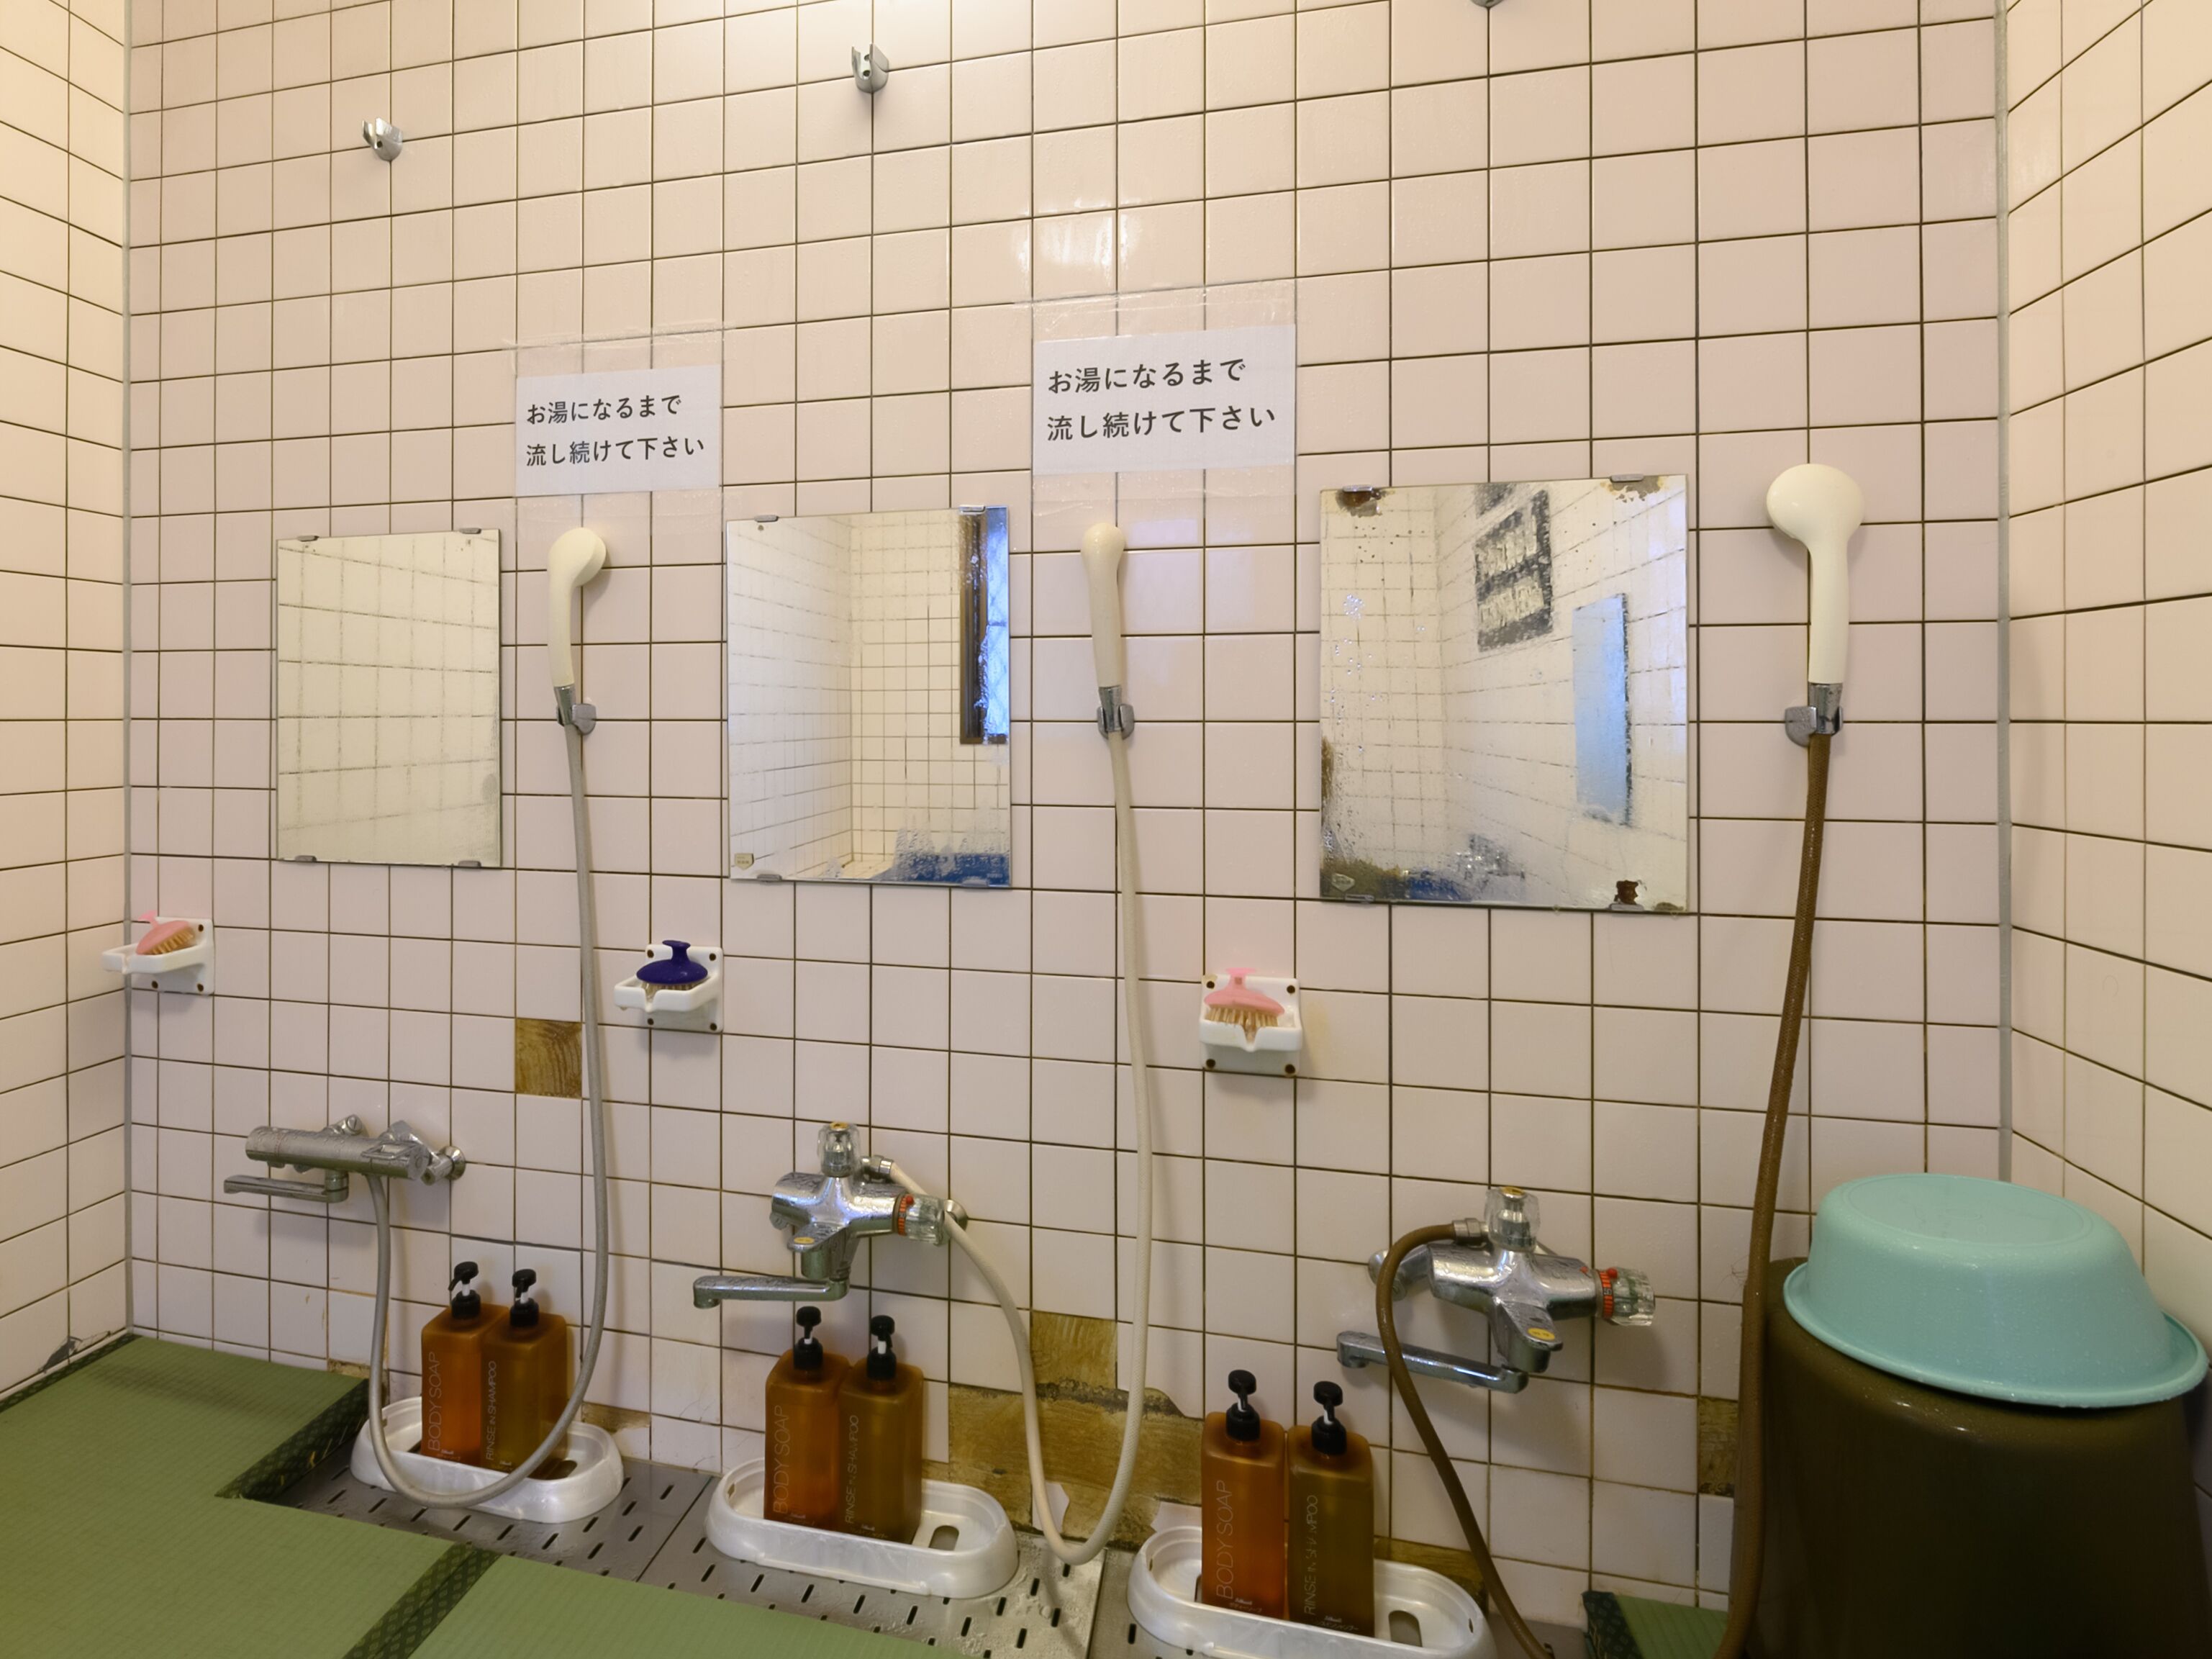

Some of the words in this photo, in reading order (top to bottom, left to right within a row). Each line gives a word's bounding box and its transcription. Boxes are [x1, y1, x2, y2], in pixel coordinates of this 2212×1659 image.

[1048, 358, 1246, 394] お湯になるまで
[527, 394, 681, 425] お湯になるまで
[1047, 405, 1275, 441] 流し続けて下さい
[526, 435, 704, 466] 流し続けて下さい
[428, 1352, 442, 1398] SOAP
[487, 1360, 497, 1415] SHAMPOO
[428, 1400, 442, 1451] BODY
[486, 1426, 496, 1460] RINSE
[774, 1405, 790, 1456] SOAP
[848, 1415, 859, 1475] SHAMPOO
[773, 1458, 790, 1514] BODY
[845, 1486, 856, 1524] RINSE
[1216, 1480, 1233, 1536] SOAP
[1216, 1538, 1233, 1599] BODY
[1304, 1575, 1316, 1615] RINSE
